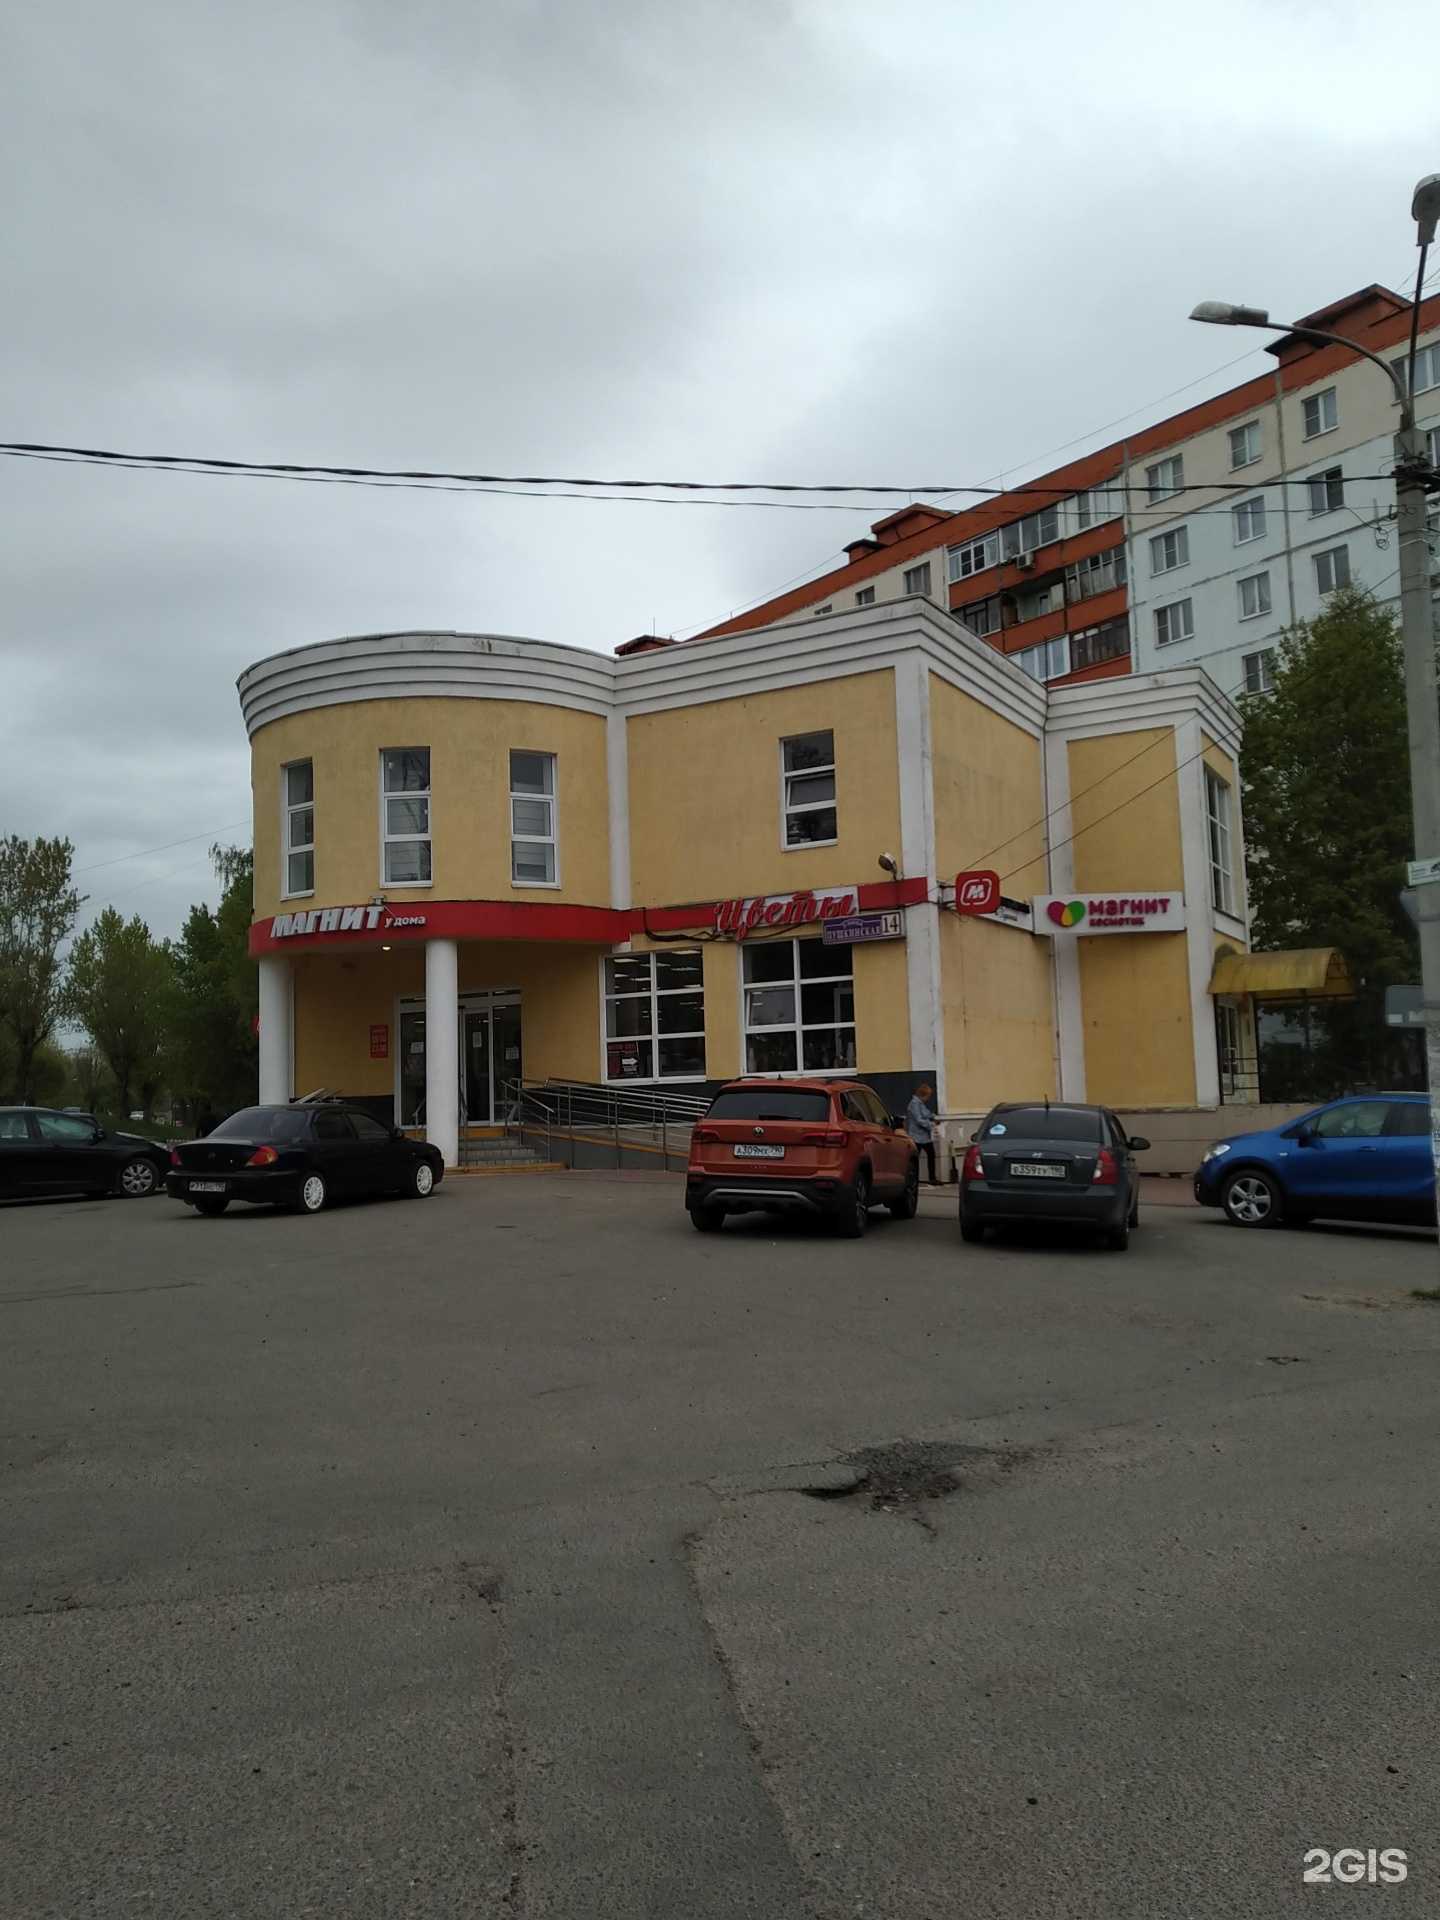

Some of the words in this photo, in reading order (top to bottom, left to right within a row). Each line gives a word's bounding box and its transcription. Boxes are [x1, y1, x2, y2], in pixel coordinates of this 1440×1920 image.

[270, 905, 384, 938] МАГНИТ
[394, 915, 426, 927] дома
[713, 891, 856, 941] Цветы
[883, 915, 898, 933] 14
